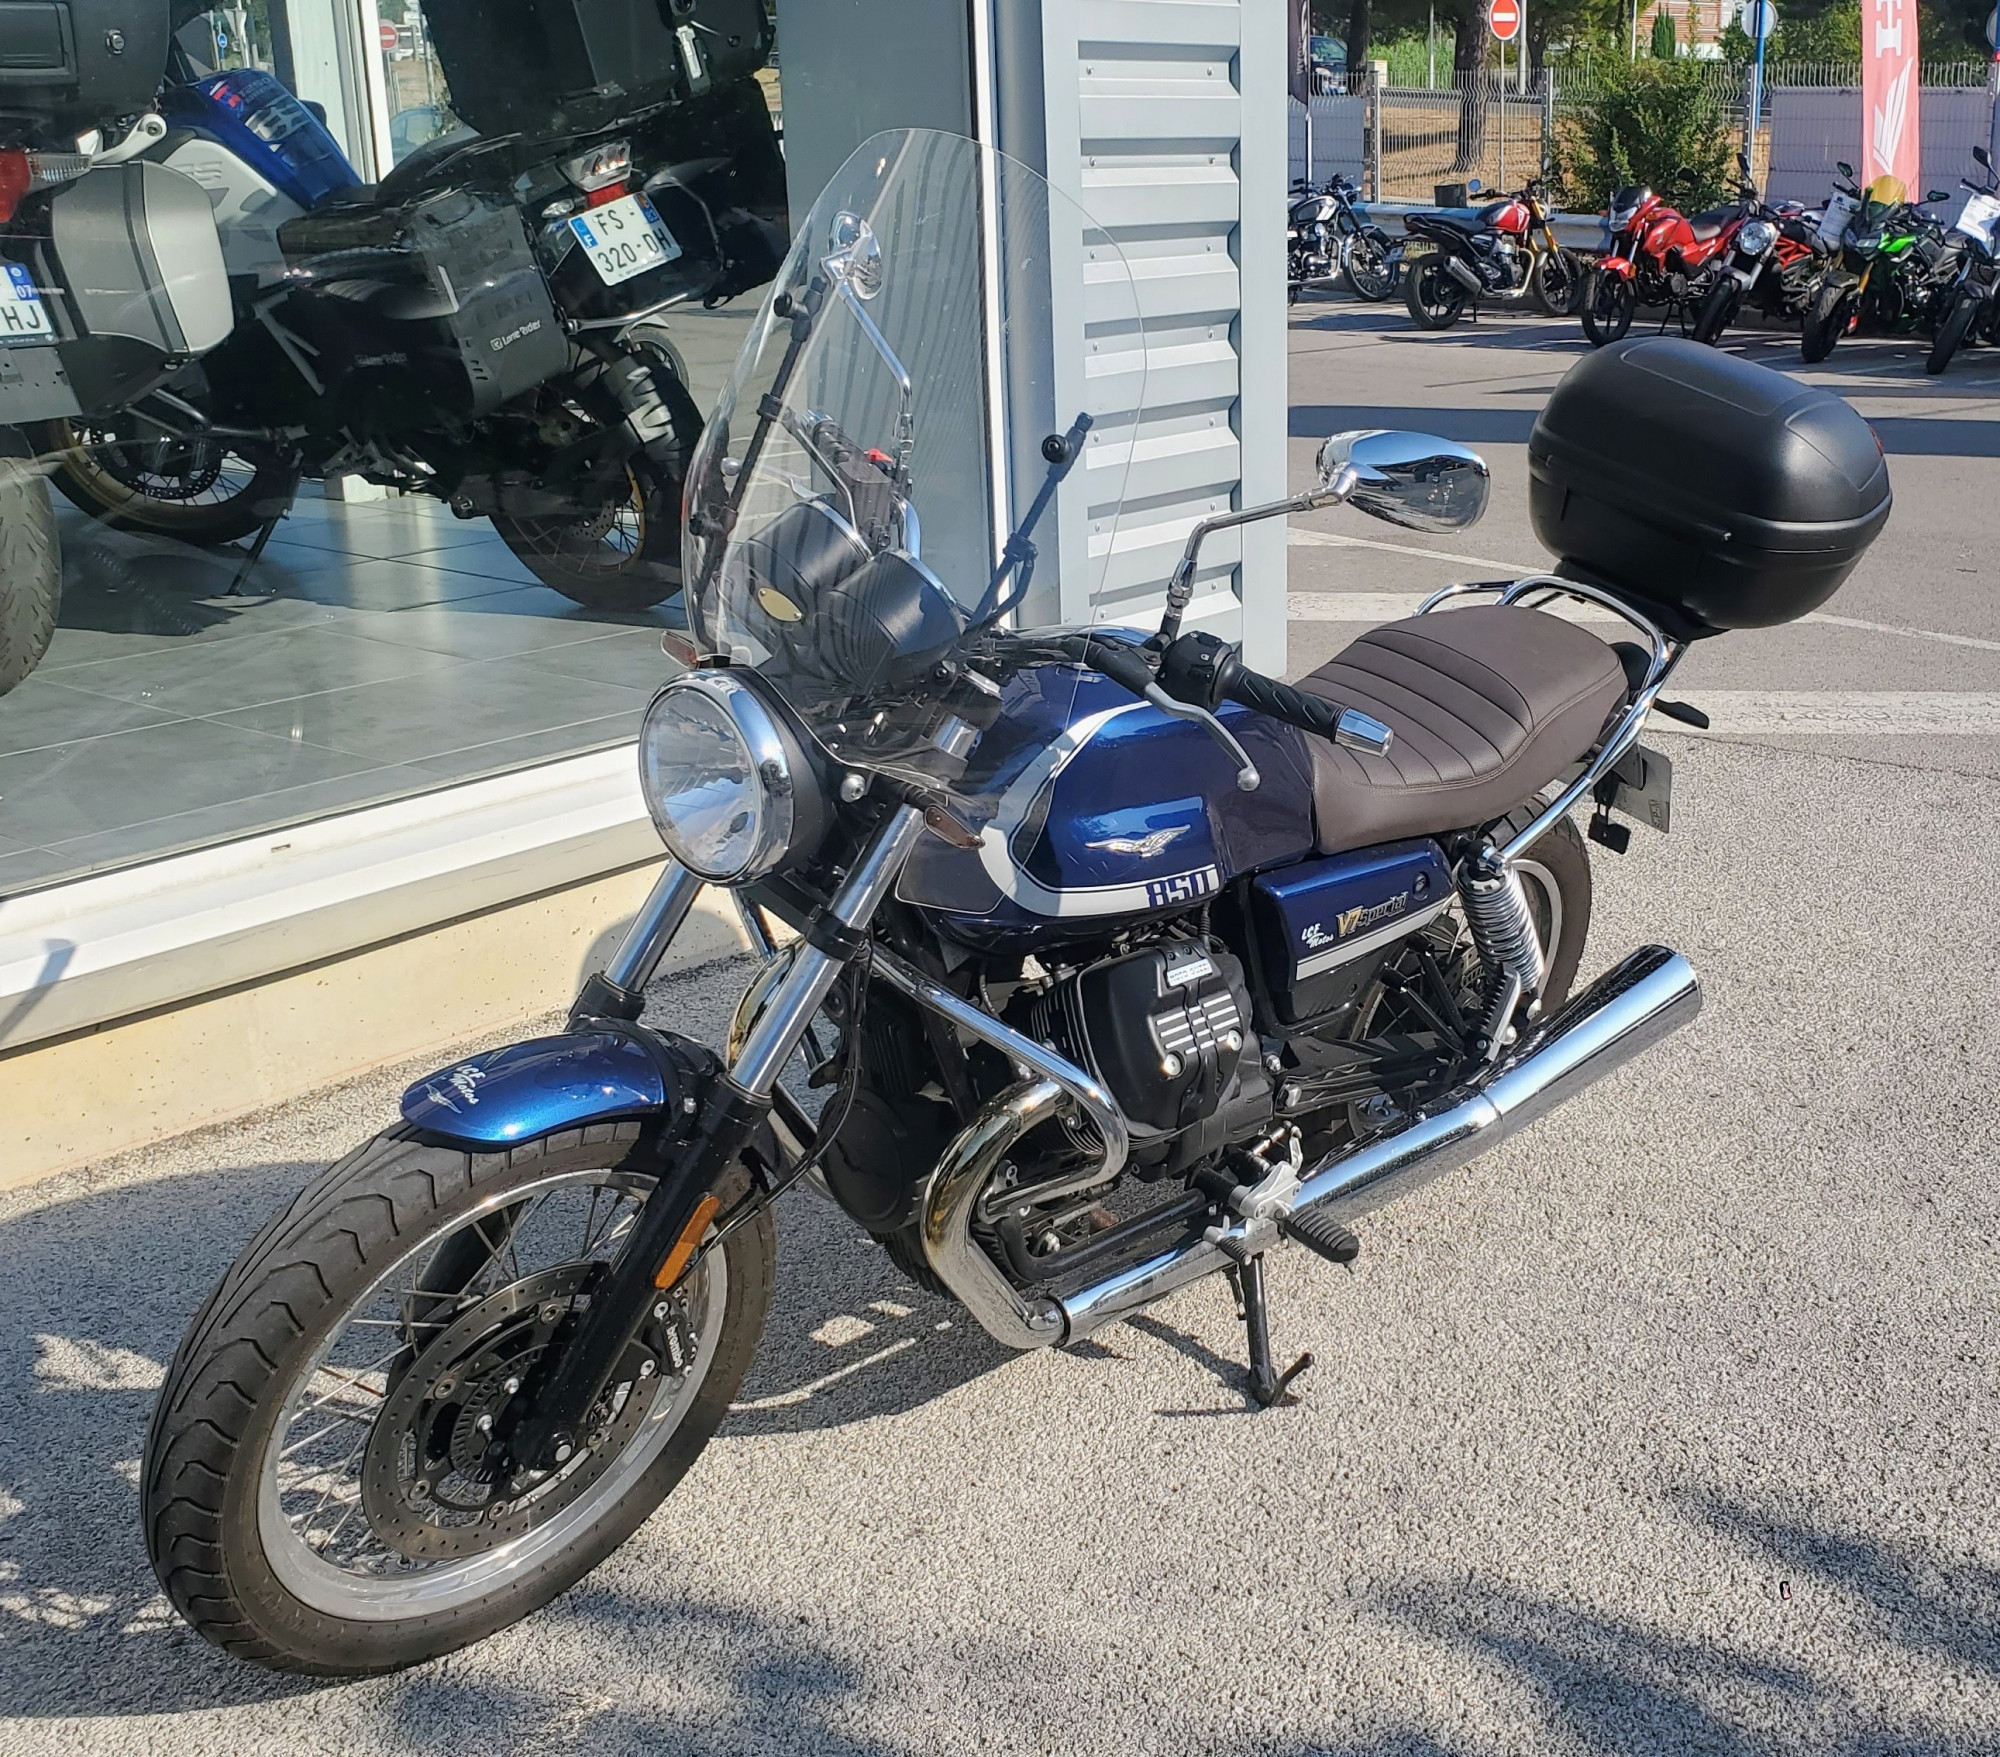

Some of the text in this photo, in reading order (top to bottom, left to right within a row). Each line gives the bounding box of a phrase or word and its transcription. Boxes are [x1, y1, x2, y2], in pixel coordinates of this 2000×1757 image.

[16, 284, 33, 298] 07
[1146, 869, 1210, 907] 850
[665, 1322, 685, 1368] brembo
